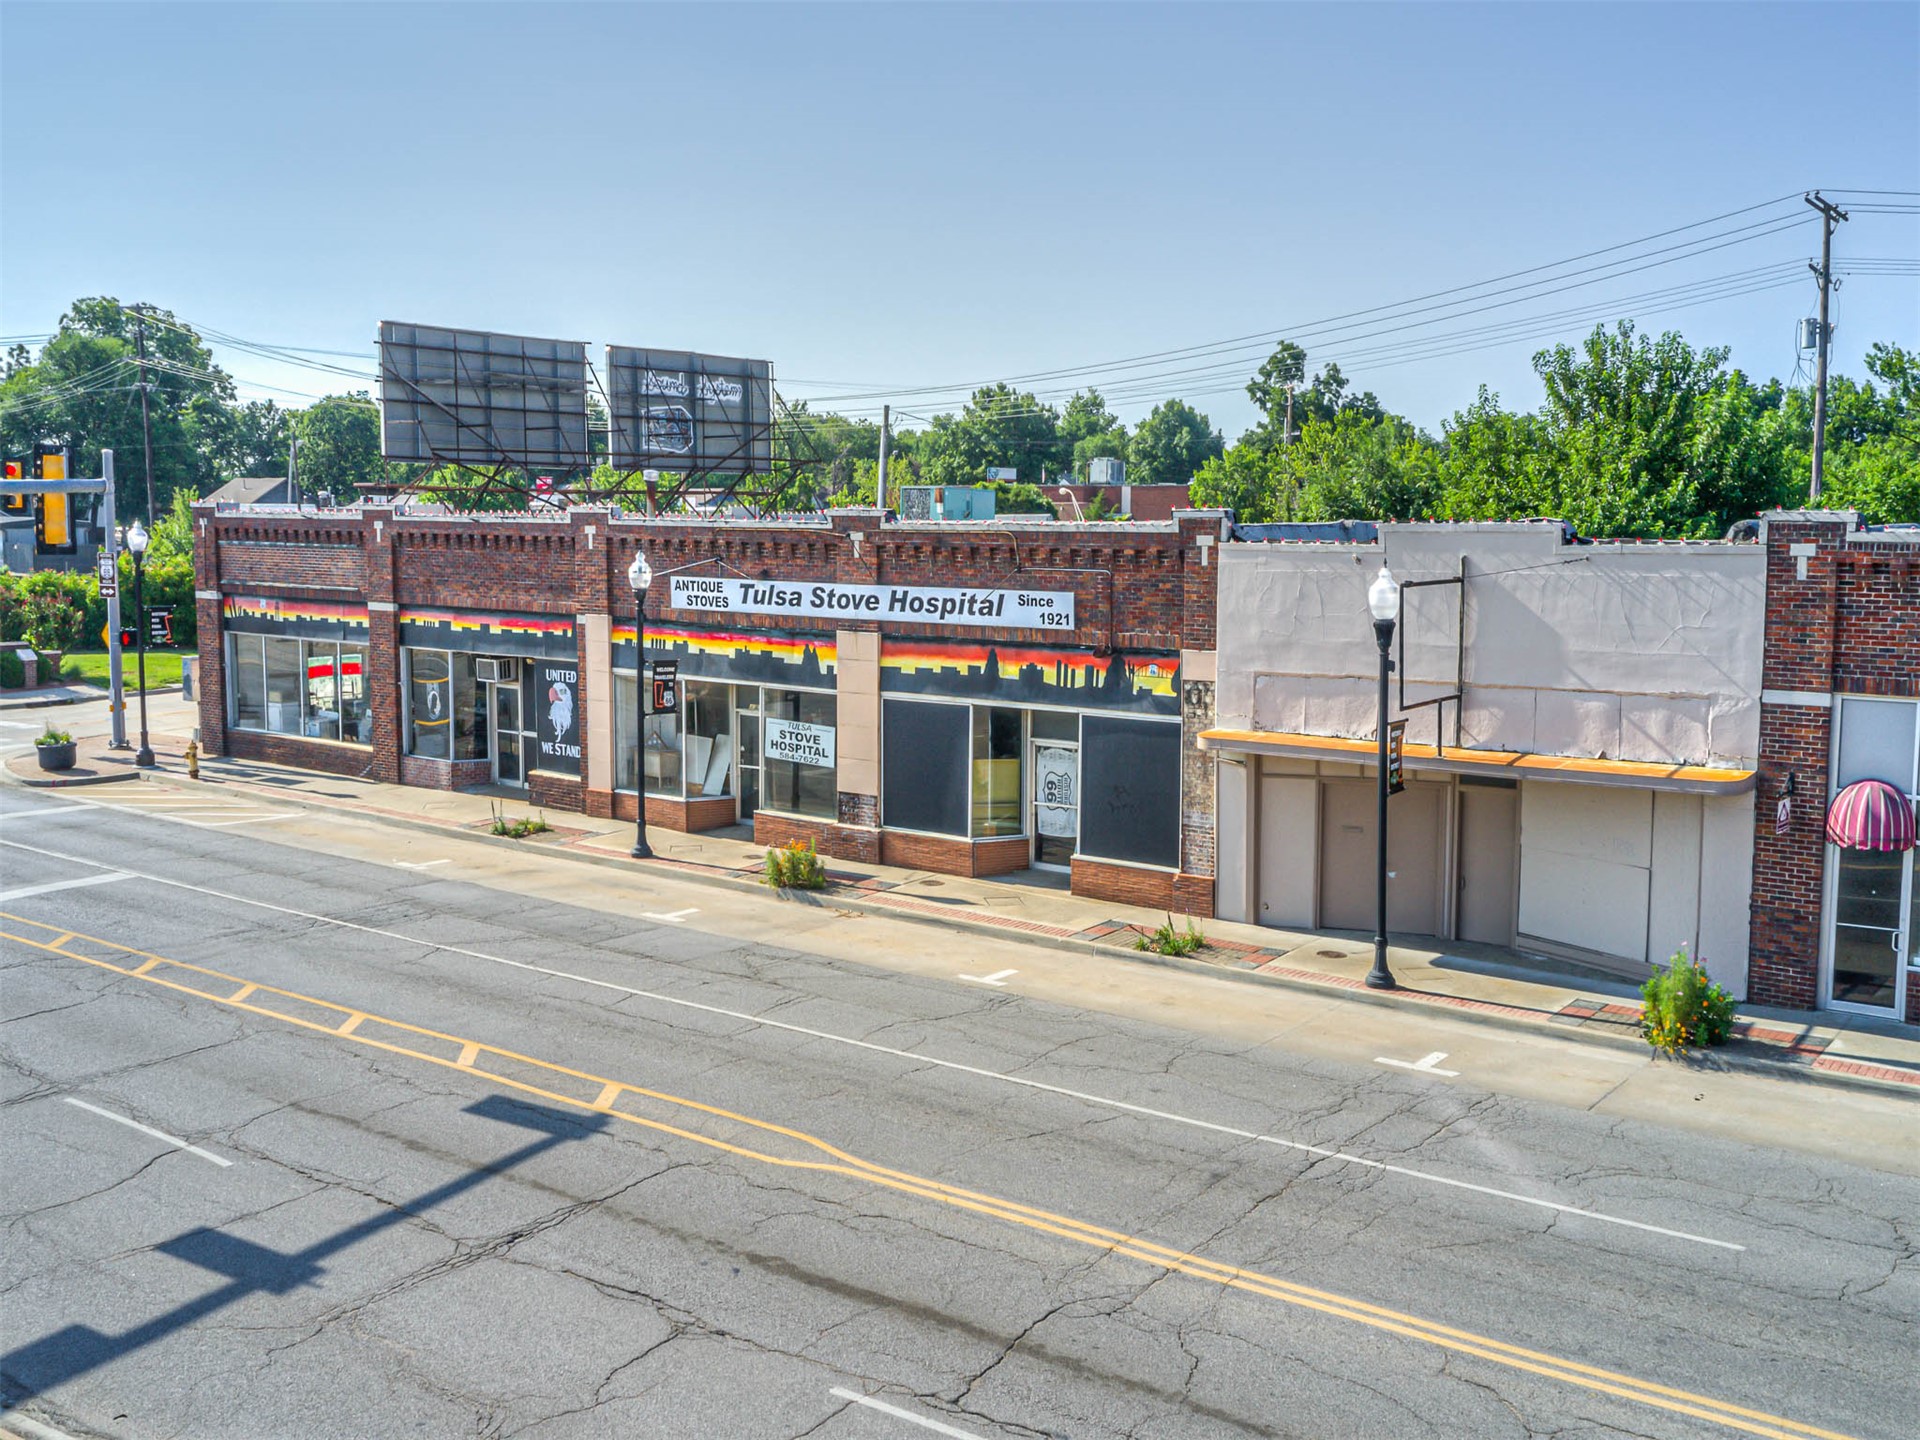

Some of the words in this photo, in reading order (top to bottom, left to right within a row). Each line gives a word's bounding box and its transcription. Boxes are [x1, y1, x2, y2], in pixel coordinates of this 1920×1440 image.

[674, 579, 723, 594] ANTIQUE
[686, 594, 729, 608] STOVES
[739, 583, 802, 607] Tulsa
[810, 586, 880, 611] Stove
[888, 589, 1005, 620] Hospital
[1018, 594, 1054, 608] Since
[1039, 612, 1070, 626] 1921
[546, 669, 577, 682] UNITED
[788, 722, 812, 732] TULSA
[779, 729, 821, 745] STOVE
[541, 741, 554, 755] WE
[555, 743, 581, 758] STAND
[771, 740, 829, 758] HOSPITAL
[780, 752, 820, 764] 584-7622
[1046, 780, 1057, 803] 66
